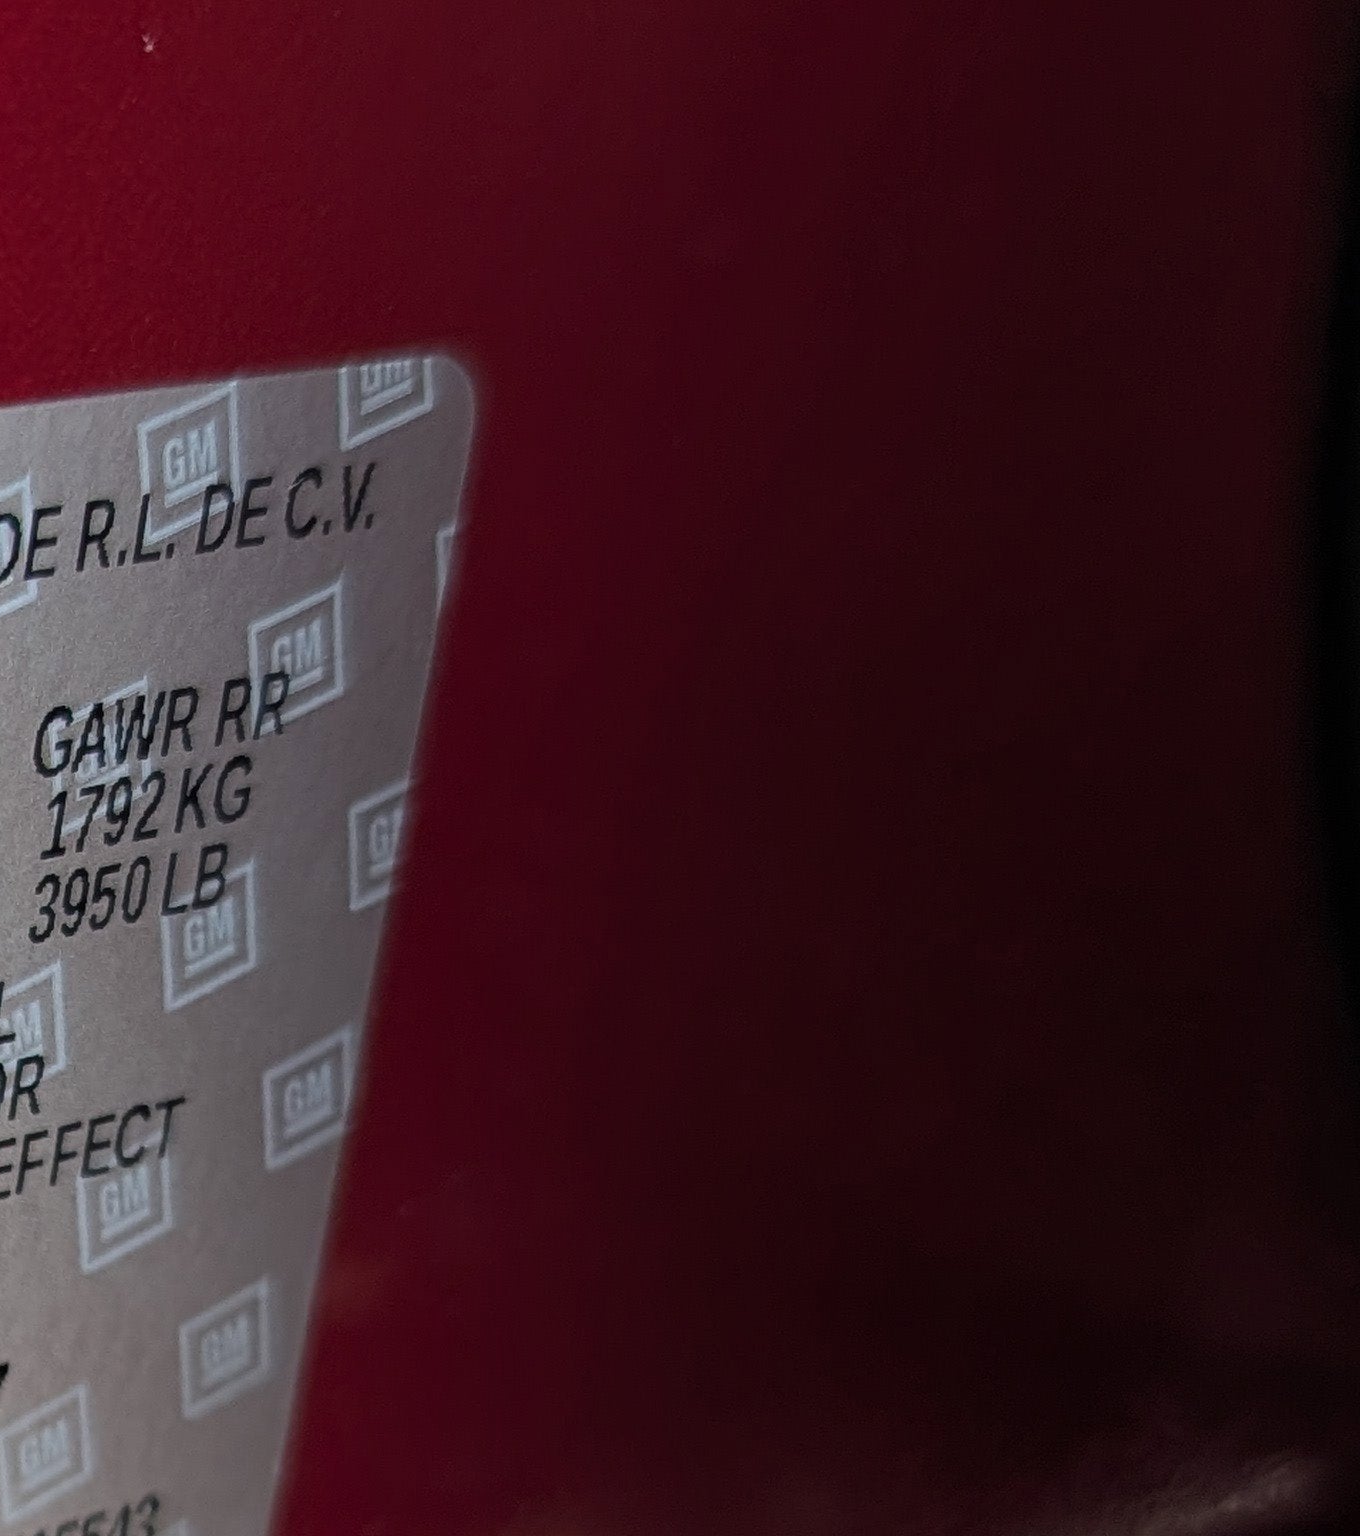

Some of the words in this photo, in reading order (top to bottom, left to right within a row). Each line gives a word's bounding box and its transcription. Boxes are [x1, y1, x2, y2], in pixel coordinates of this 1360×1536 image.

[77, 492, 176, 571] R.L.
[197, 476, 274, 556] DE
[286, 462, 376, 538] C.V.
[33, 685, 199, 779] GAWR
[216, 671, 291, 748] RR
[38, 770, 167, 861] 1792
[175, 756, 254, 836] KG
[28, 854, 150, 945] 3950
[160, 841, 229, 918] LB
